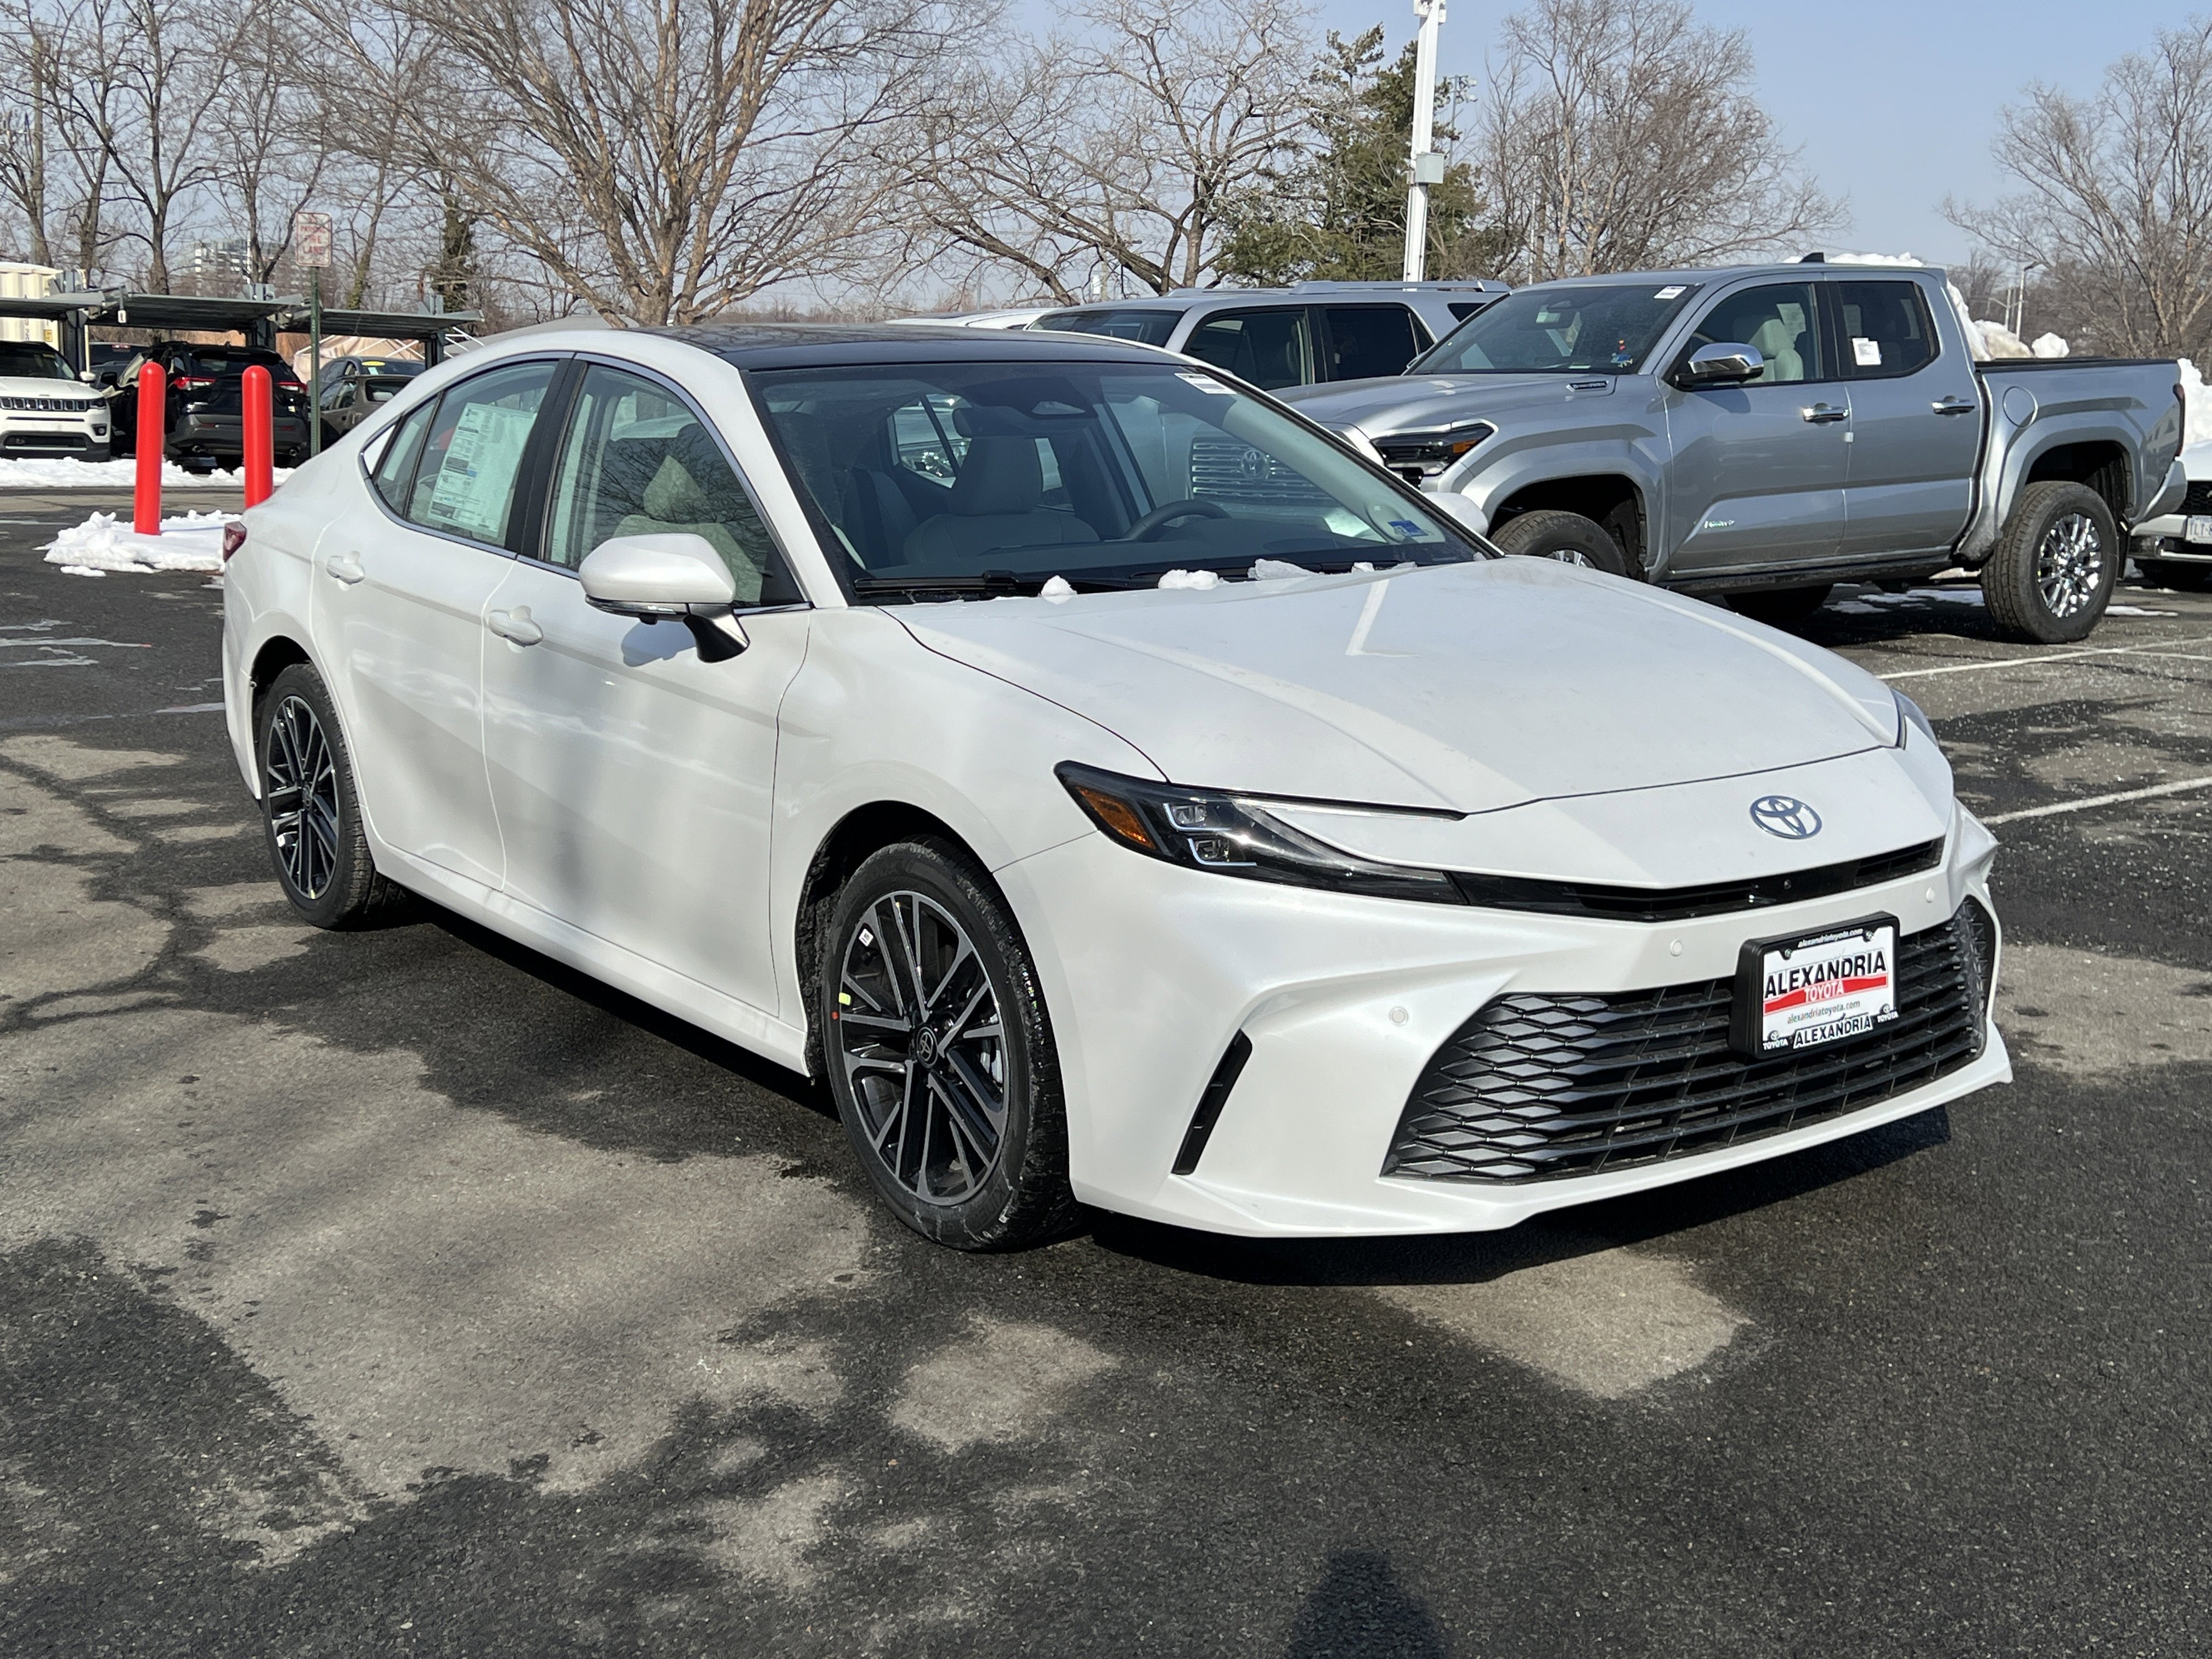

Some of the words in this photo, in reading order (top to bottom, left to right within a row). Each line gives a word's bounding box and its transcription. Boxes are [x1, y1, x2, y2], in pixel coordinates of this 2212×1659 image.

[303, 246, 323, 255] LANE
[1764, 950, 1887, 999] ALEXANDRIA
[1804, 981, 1844, 1002] TOYOTA
[1787, 1000, 1861, 1025] alexandriatoyota.com
[1877, 1012, 1899, 1023] TOYOTA
[1795, 1019, 1871, 1046] ALEXANDRIA
[1763, 1039, 1788, 1051] TOYOTA
